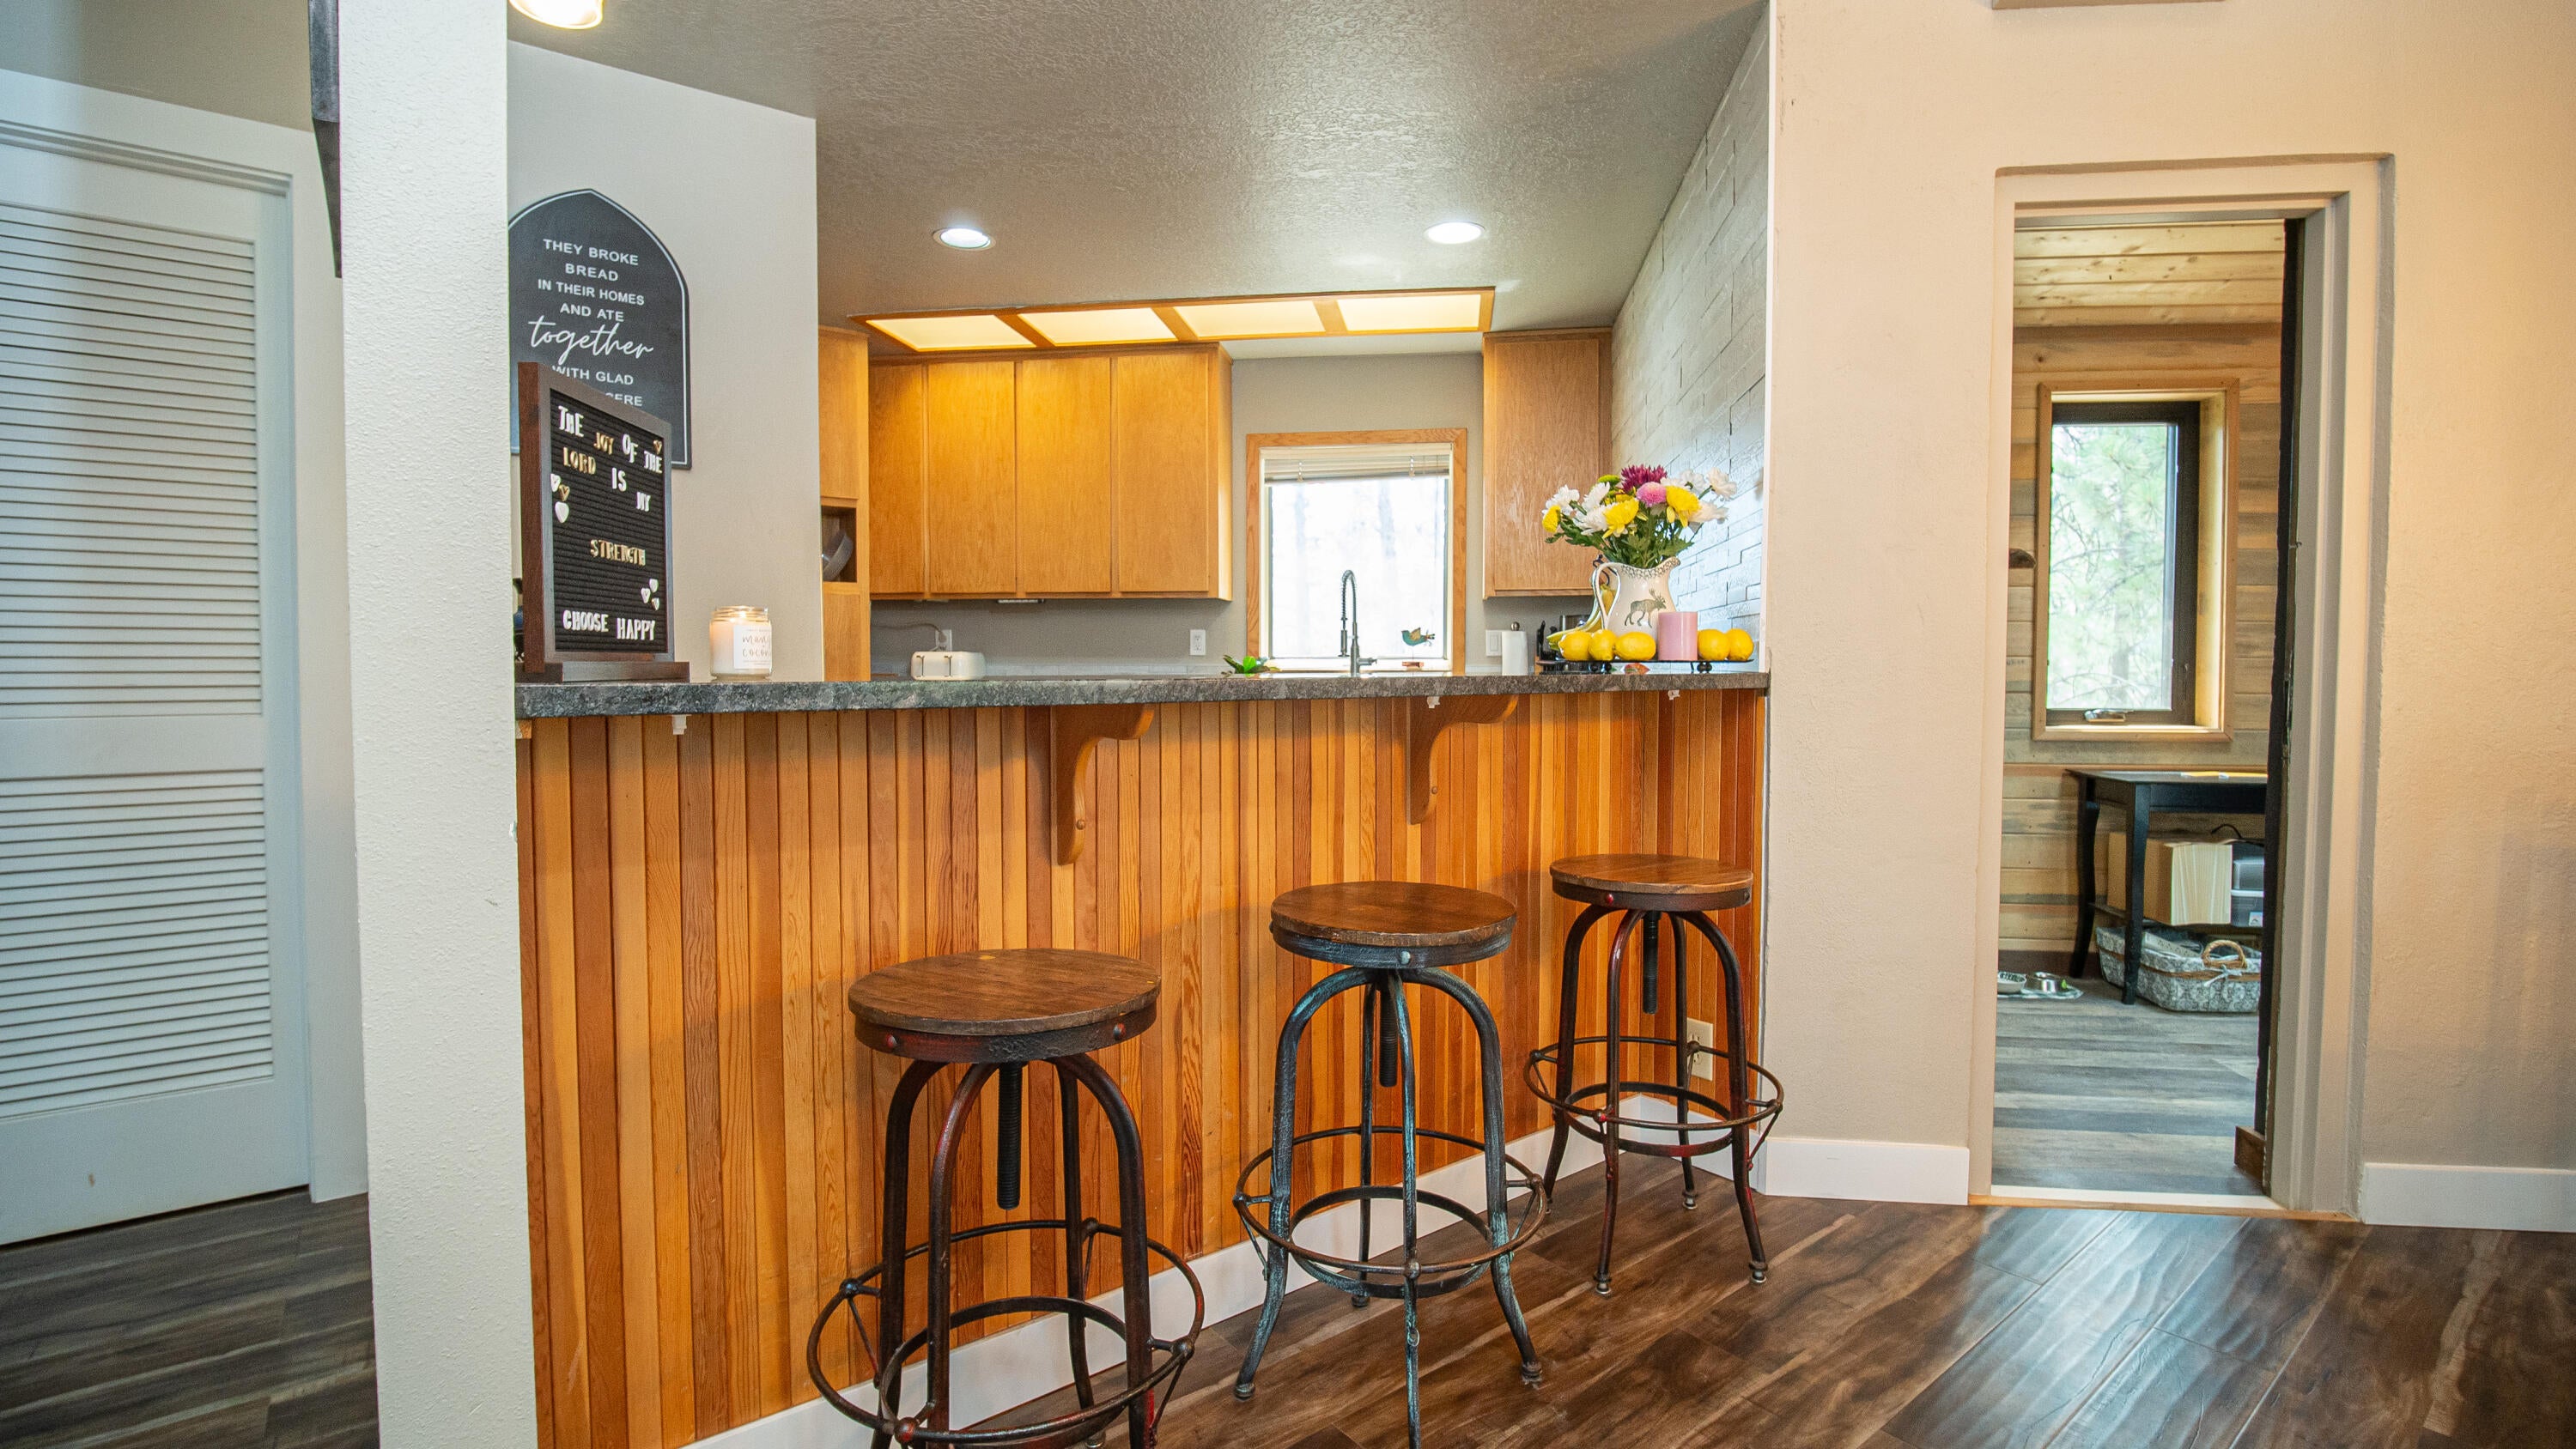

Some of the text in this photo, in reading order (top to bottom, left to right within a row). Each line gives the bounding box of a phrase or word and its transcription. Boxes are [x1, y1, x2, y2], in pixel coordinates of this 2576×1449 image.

[543, 239, 639, 266] THEY BROKE
[565, 263, 618, 282] BREAD
[538, 279, 645, 306] IN THEIR HOMES
[560, 302, 624, 322] AND ATE
[528, 315, 653, 365] together
[551, 365, 634, 385] WITH GLAD
[558, 405, 663, 474] THE JOY OF THE
[562, 446, 651, 512] LORD IS MY
[590, 539, 646, 567] STRENGTH
[562, 609, 656, 641] CHOOSE HAPPY
